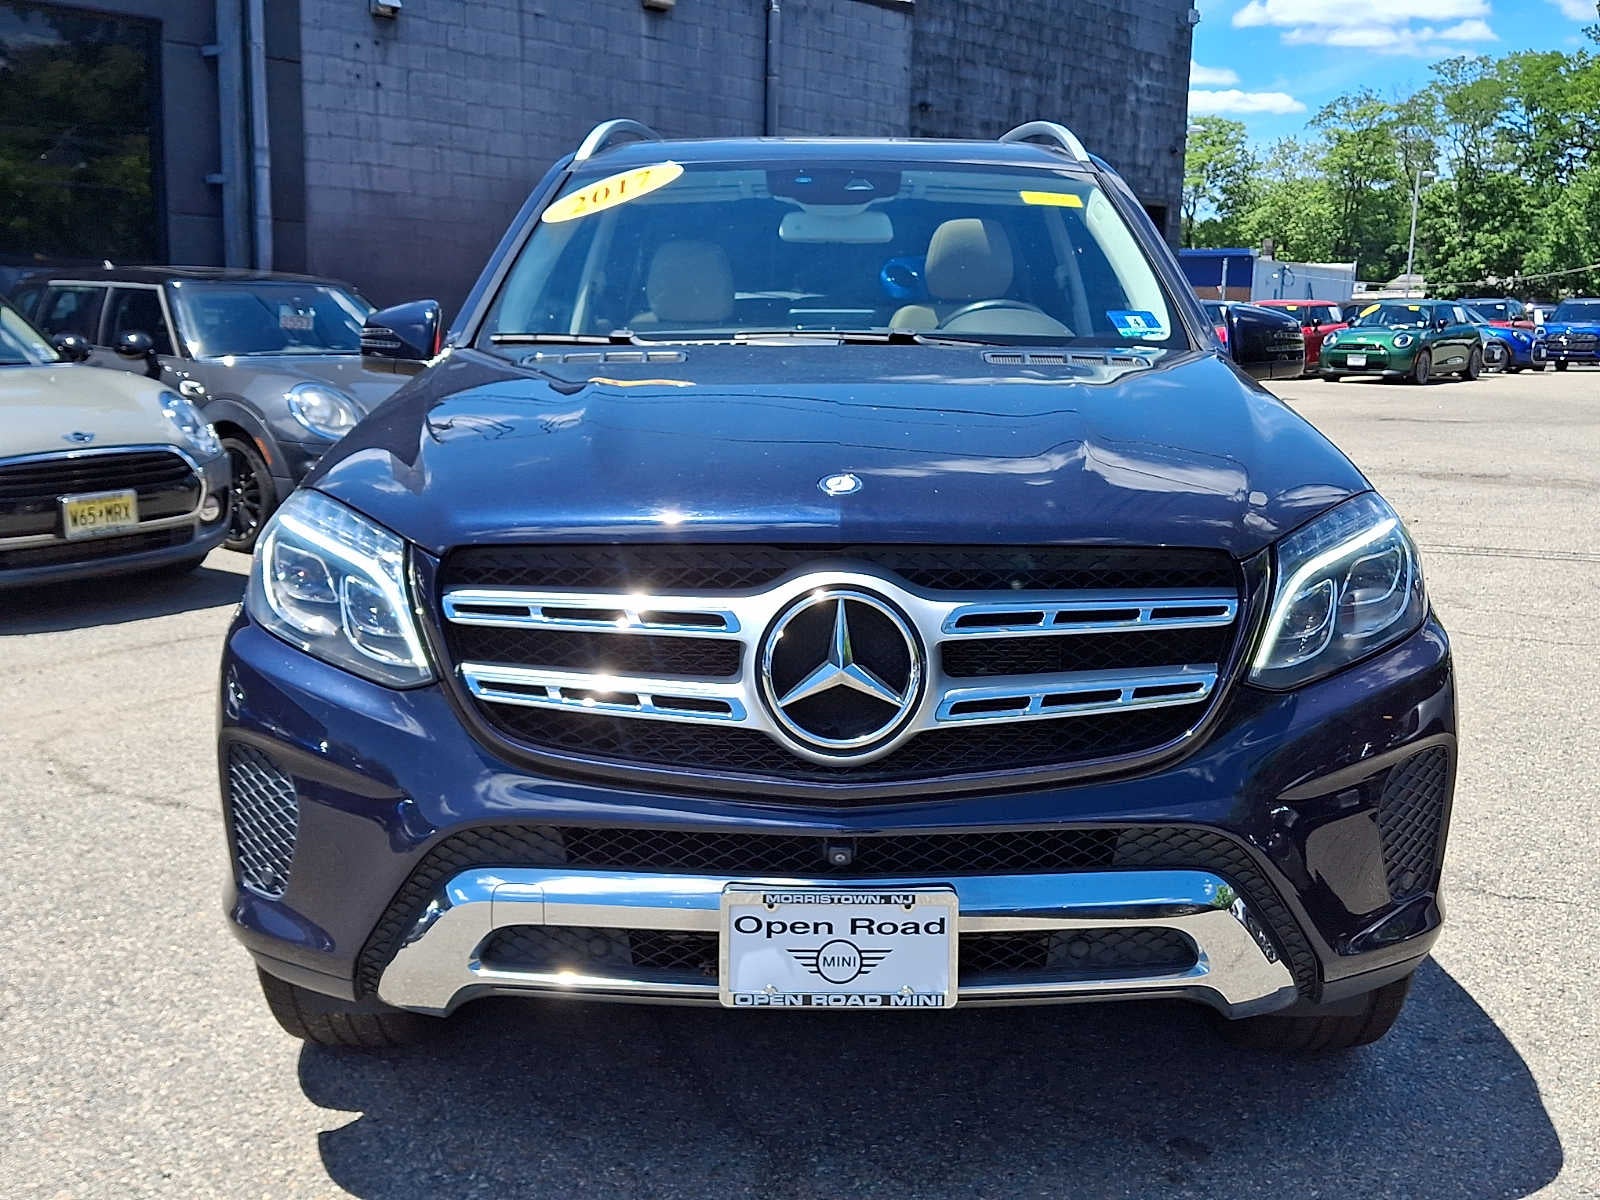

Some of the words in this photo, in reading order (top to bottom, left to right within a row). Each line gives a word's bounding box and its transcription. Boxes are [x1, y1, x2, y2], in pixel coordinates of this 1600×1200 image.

[571, 169, 652, 215] 2017
[891, 894, 914, 905] NJ
[734, 915, 834, 939] Open
[850, 917, 946, 936] Road
[822, 956, 857, 968] MINI
[734, 994, 803, 1007] OPEN
[812, 994, 883, 1007] ROAD
[889, 994, 944, 1007] MINI
